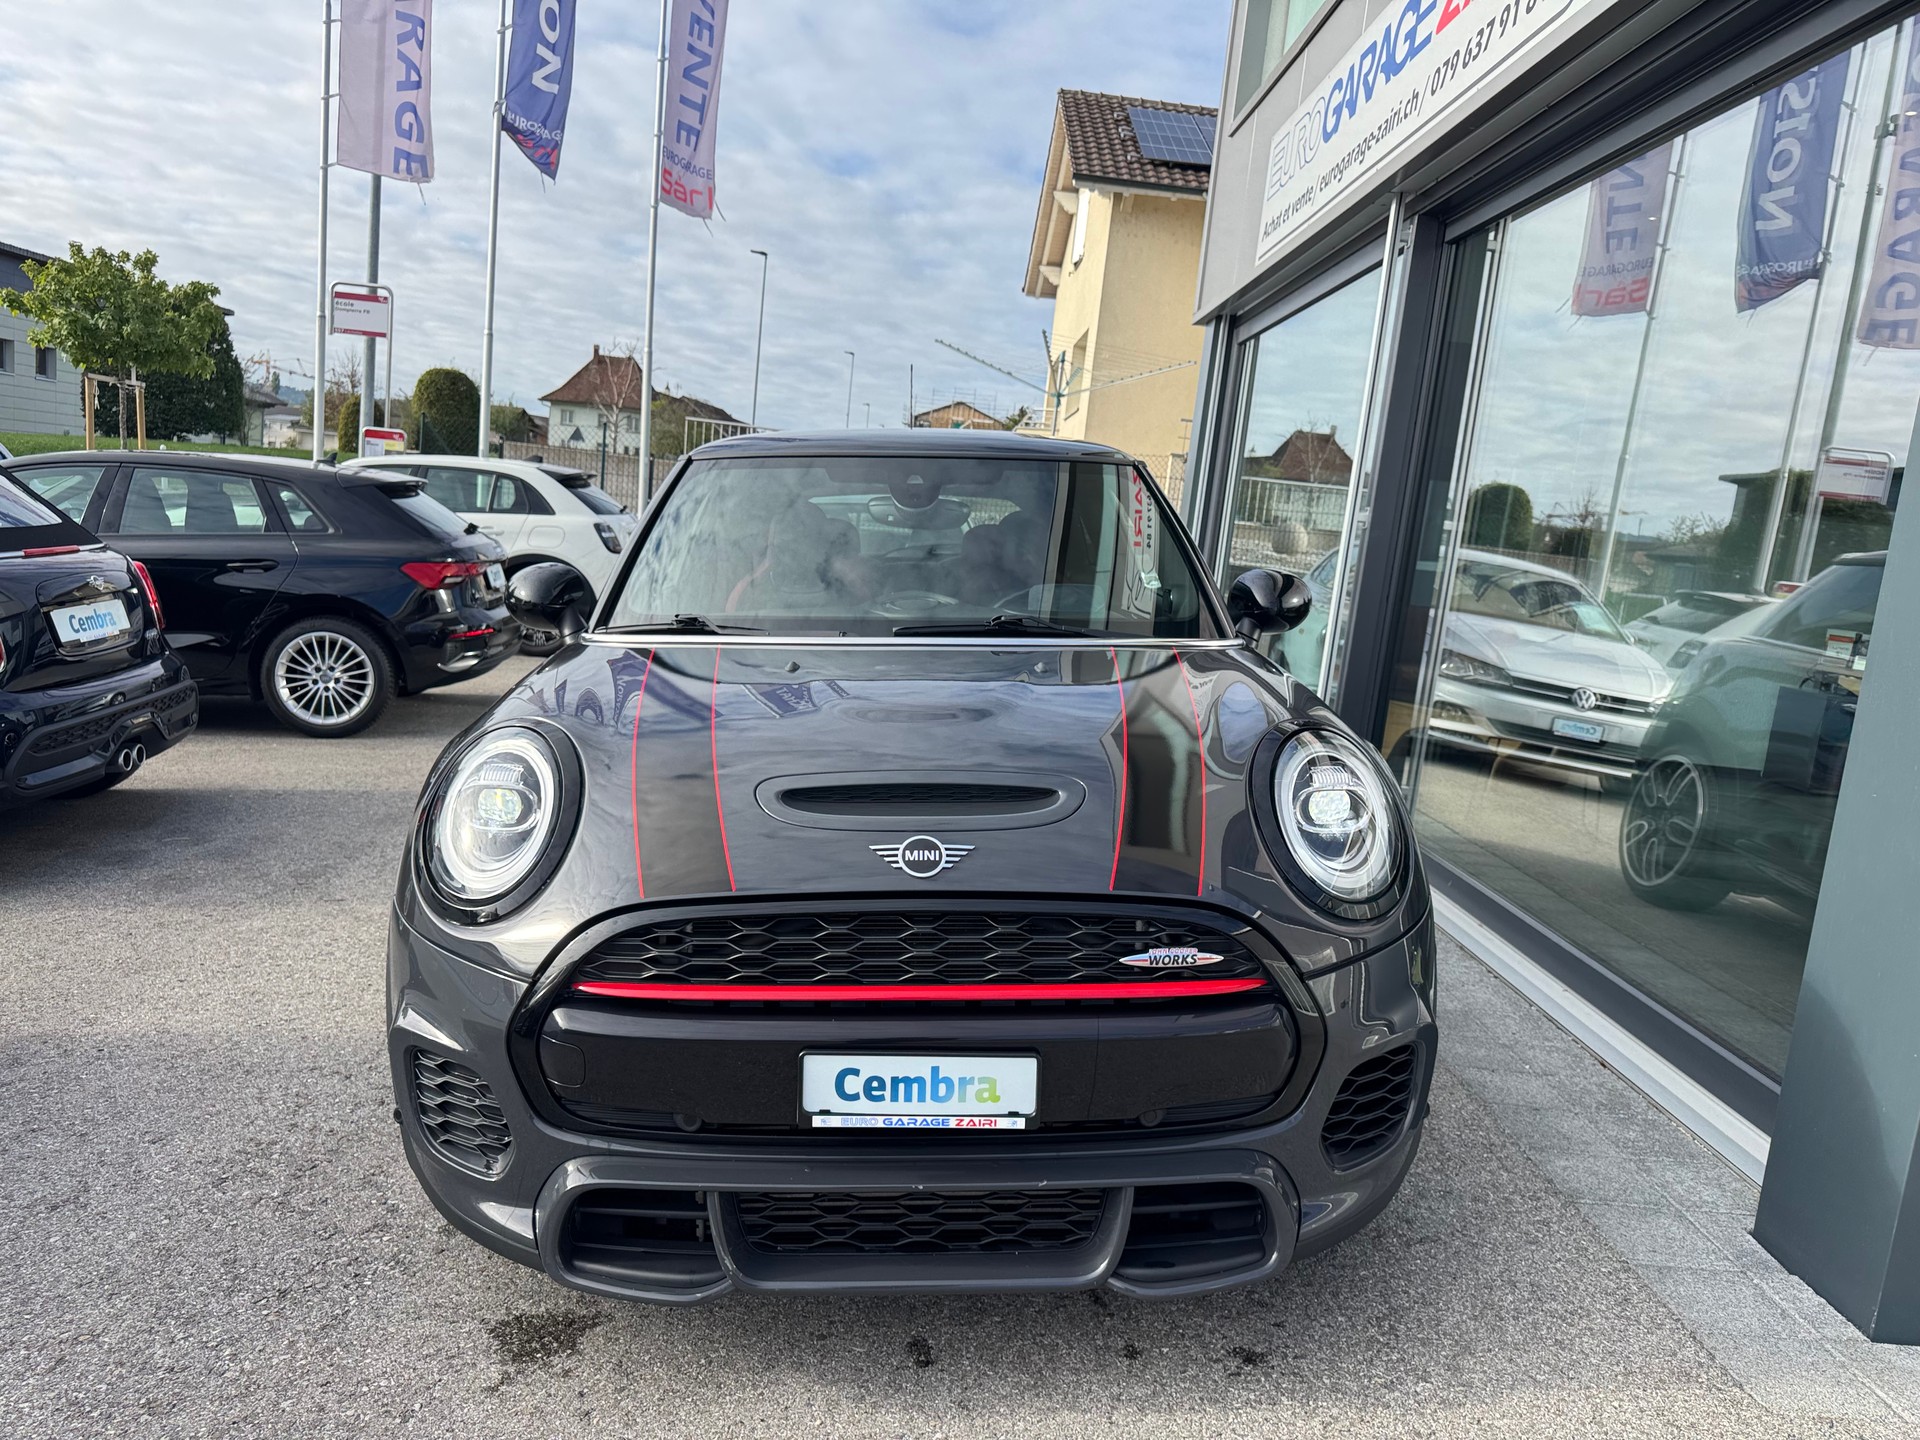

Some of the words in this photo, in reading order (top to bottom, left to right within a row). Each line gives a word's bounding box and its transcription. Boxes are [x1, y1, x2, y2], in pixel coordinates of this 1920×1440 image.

[676, 0, 716, 152] ENTE
[1262, 210, 1282, 242] Achat
[1291, 186, 1314, 214] vente
[1431, 49, 1460, 97] 079
[1462, 16, 1497, 70] 637
[68, 608, 117, 634] Cembra
[905, 850, 940, 861] MINI
[1149, 954, 1198, 966] WORKS
[834, 1066, 1001, 1104] Cembra
[840, 1117, 879, 1127] EURO
[882, 1117, 951, 1127] GARAGE
[955, 1118, 998, 1128] ZAIRI
